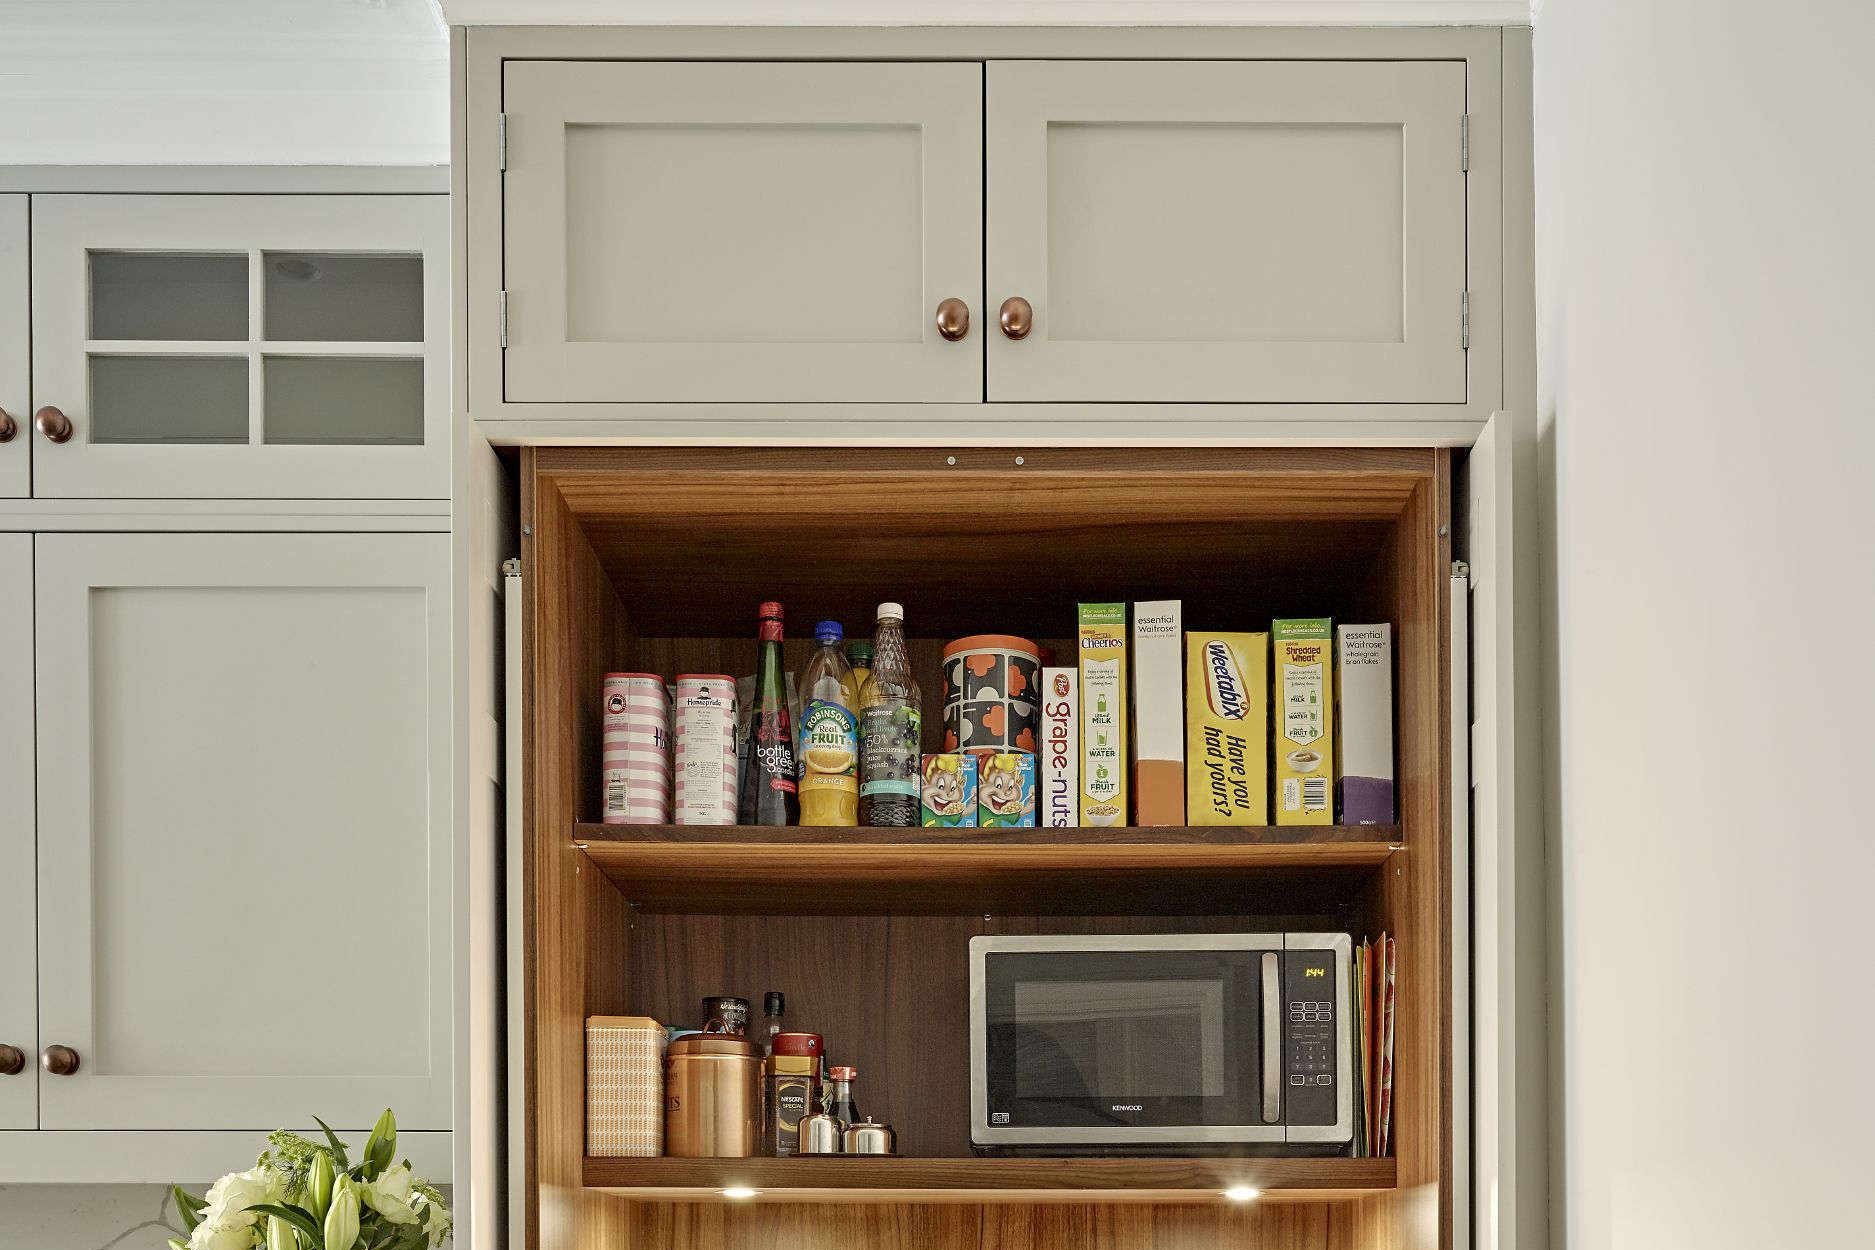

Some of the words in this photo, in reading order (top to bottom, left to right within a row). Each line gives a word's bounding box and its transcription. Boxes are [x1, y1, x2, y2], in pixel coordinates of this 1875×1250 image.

[1138, 615, 1174, 624] essential
[1346, 631, 1382, 639] essential
[1082, 638, 1123, 649] Cheerios
[1286, 646, 1320, 655] Shredded
[1056, 676, 1068, 695] Post
[1208, 644, 1243, 721] Weetabix
[687, 698, 722, 707] Homepride
[807, 709, 850, 730] ROBINSONS
[818, 725, 838, 733] Real
[811, 733, 846, 744] FRUIT
[866, 734, 888, 748] 50%
[1204, 726, 1226, 760] had
[757, 745, 791, 759] bottle
[1226, 735, 1246, 776] Have
[867, 761, 889, 770] squash
[1046, 702, 1071, 827] grape-nuts
[1204, 760, 1232, 817] yours?
[1228, 775, 1250, 809] you
